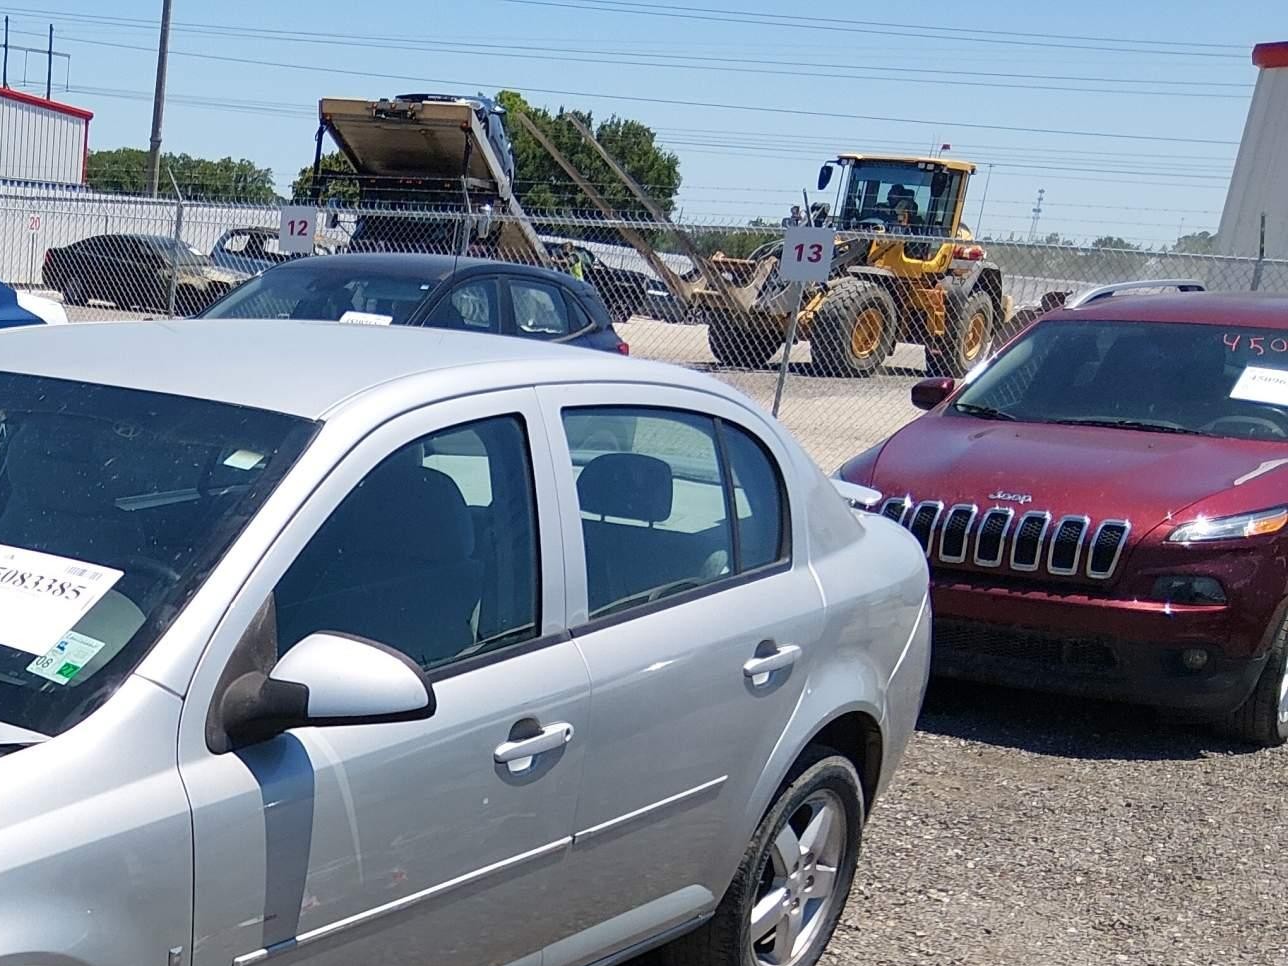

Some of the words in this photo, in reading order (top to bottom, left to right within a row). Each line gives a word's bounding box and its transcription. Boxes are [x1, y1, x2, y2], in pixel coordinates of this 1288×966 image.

[29, 216, 41, 231] 20
[287, 220, 308, 236] 12
[794, 243, 823, 263] 13
[988, 489, 1032, 505] Jeep
[35, 655, 54, 669] 08
